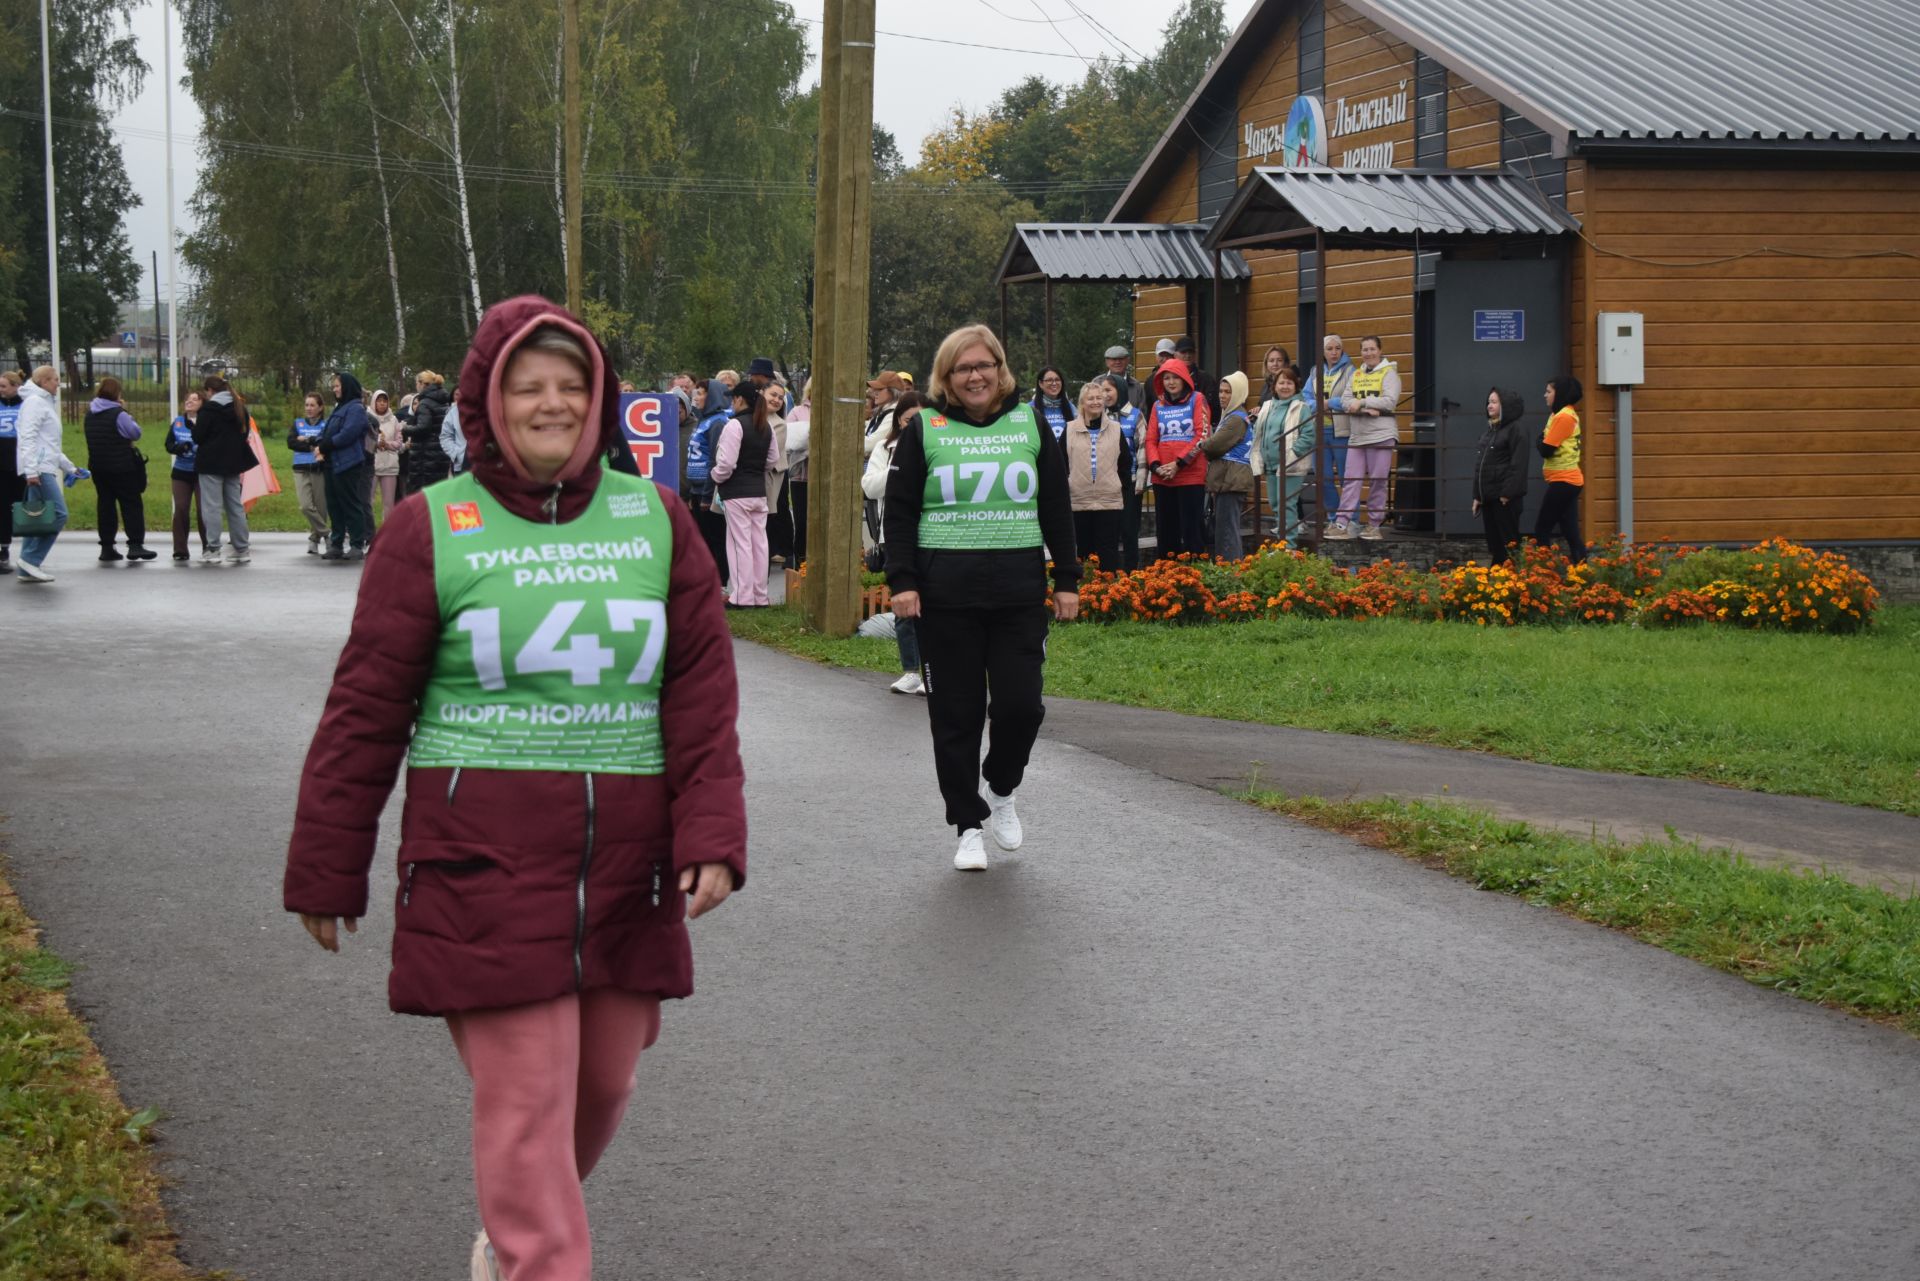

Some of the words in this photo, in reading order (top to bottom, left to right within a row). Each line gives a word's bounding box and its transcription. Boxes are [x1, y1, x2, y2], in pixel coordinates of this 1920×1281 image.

[1331, 79, 1407, 138] Лыжный
[1343, 141, 1394, 168] центр
[938, 432, 1029, 446] ТУКАЕВСКИЙ
[960, 445, 1012, 456] РАЙОН
[933, 461, 1037, 506] 170
[928, 512, 958, 523] СПОРТ
[967, 510, 1014, 521] НОРМА
[466, 537, 653, 571] ТУКАЕВСКИЙ
[514, 562, 619, 588] РАЙОН
[457, 600, 667, 690] 147
[440, 703, 510, 725] СПОРТ
[530, 702, 627, 725] НОРМА
